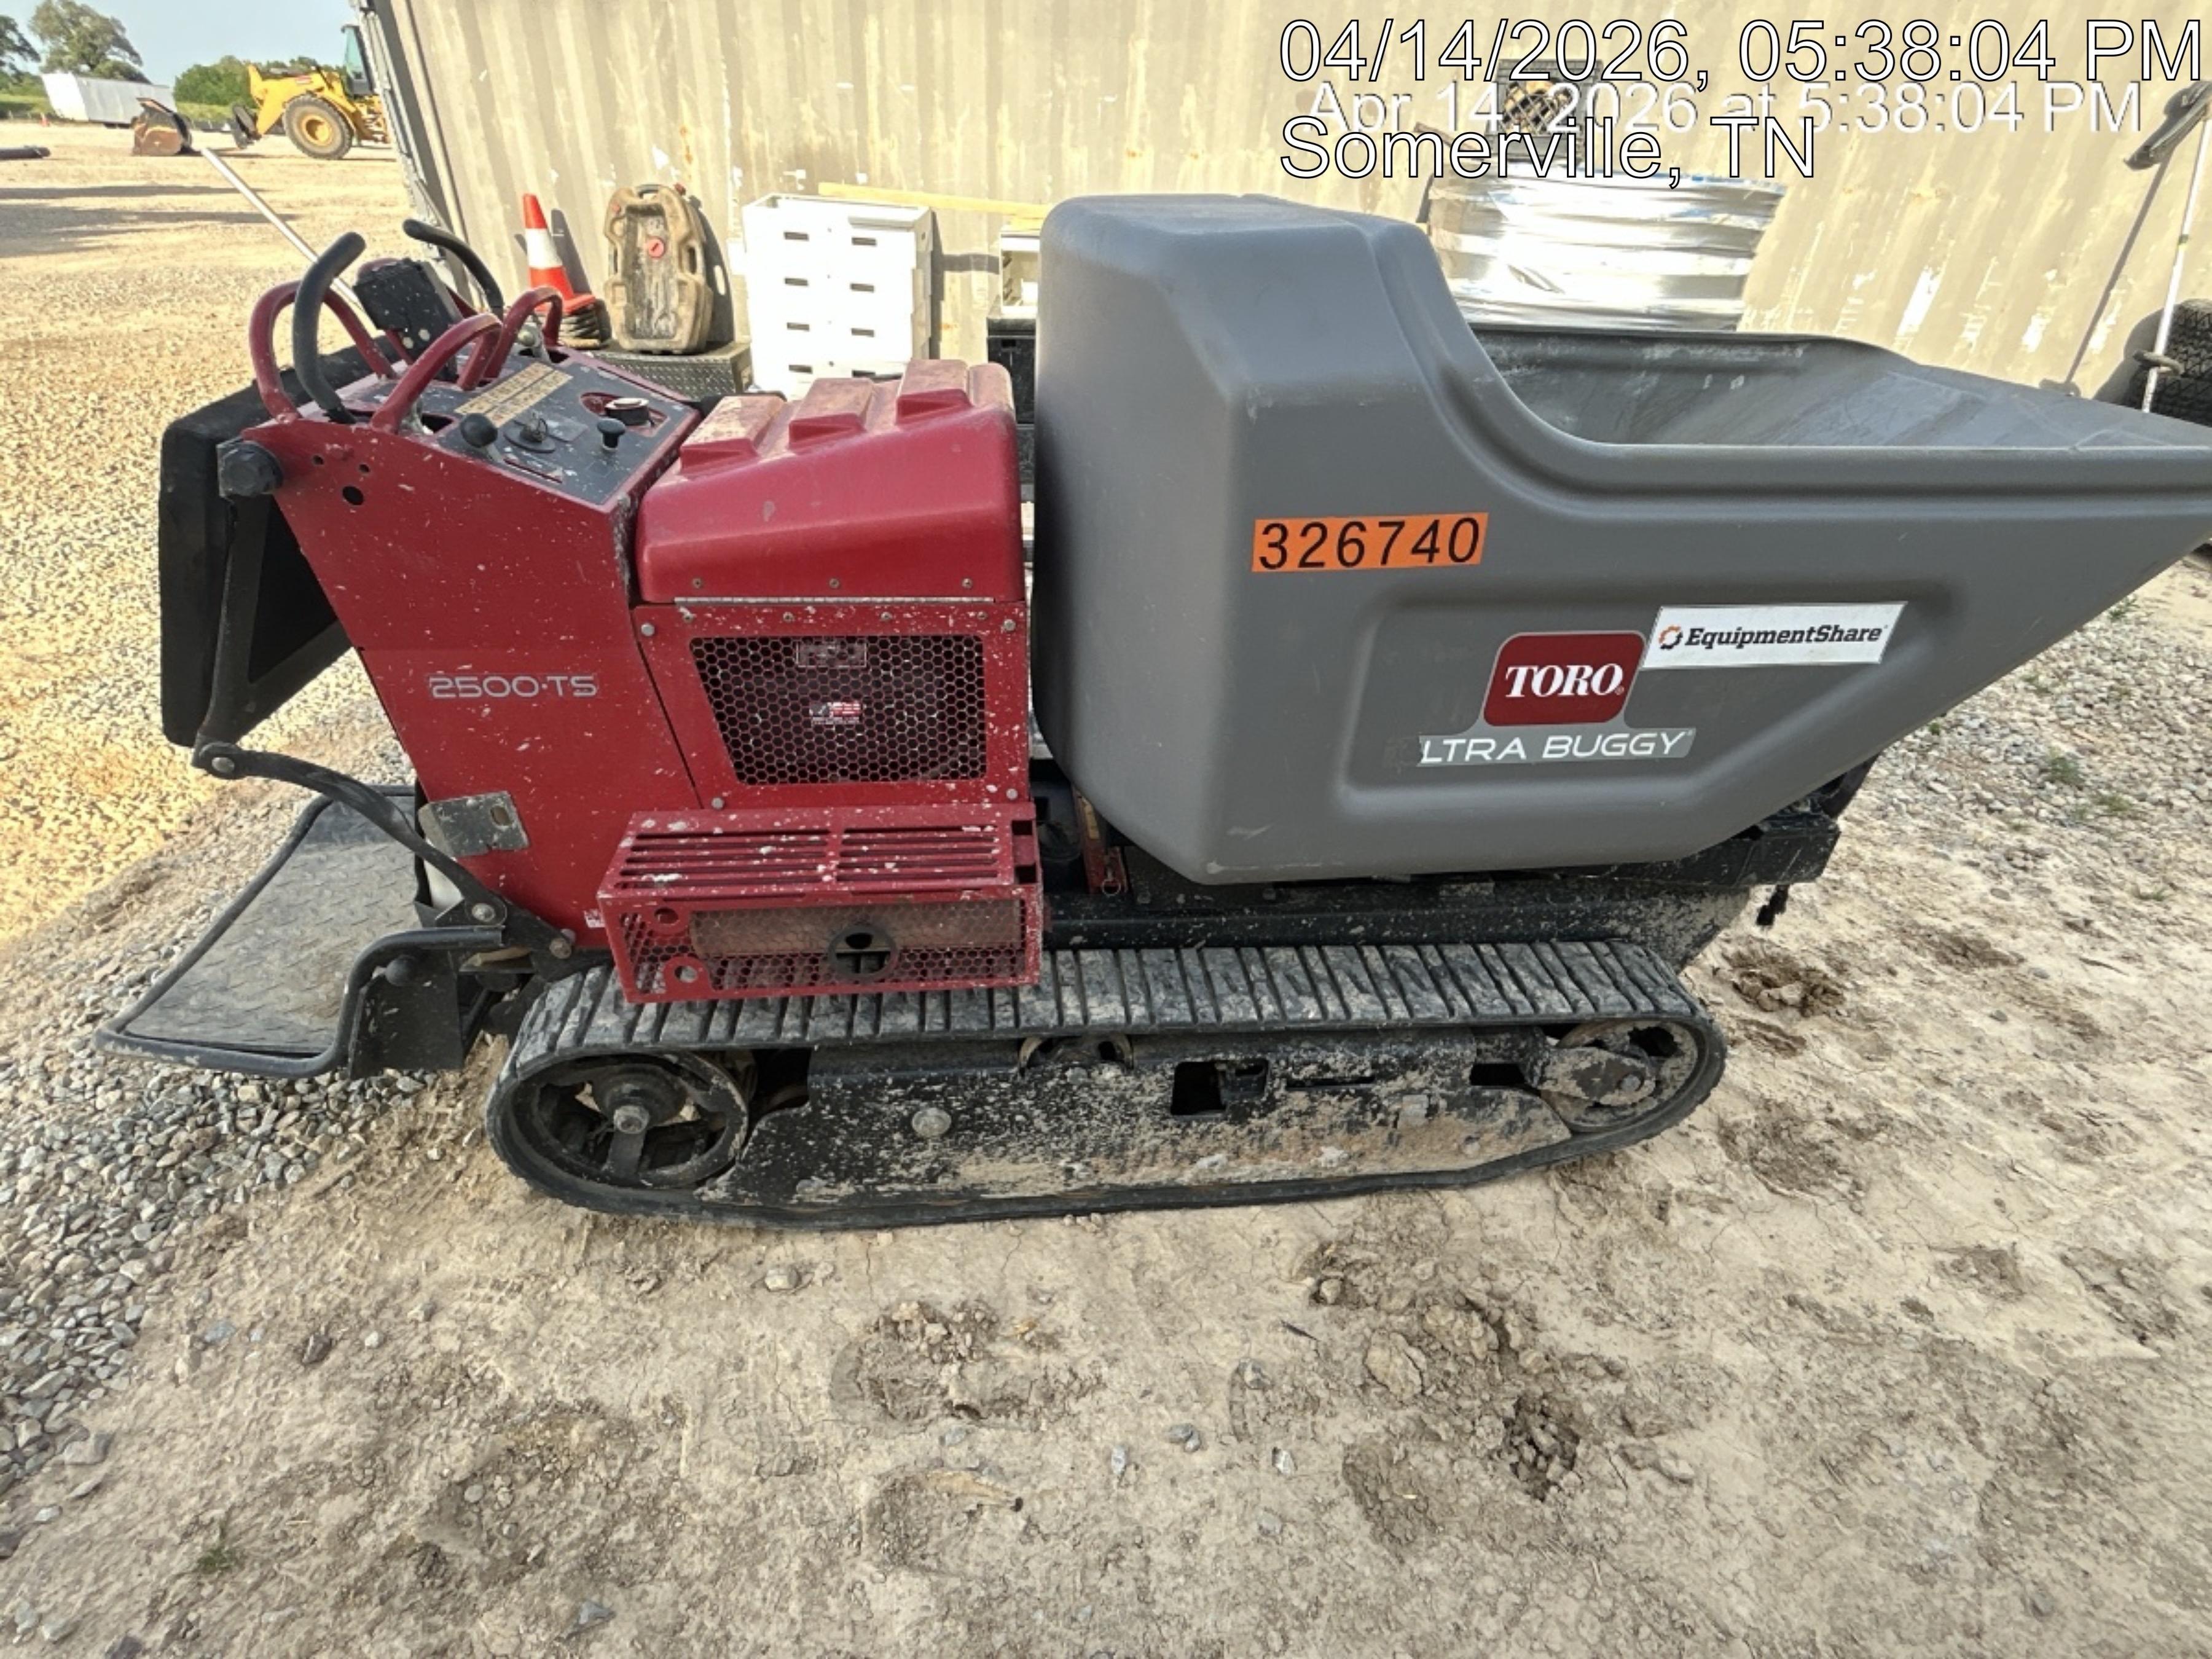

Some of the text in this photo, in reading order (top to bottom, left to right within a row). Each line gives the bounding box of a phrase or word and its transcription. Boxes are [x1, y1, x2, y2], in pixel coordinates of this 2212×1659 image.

[1259, 517, 1480, 570] 326740
[1684, 624, 1884, 649] EquipmentShare
[1505, 662, 1624, 698] TORO
[1420, 731, 1685, 764] LTRA BUGGY
